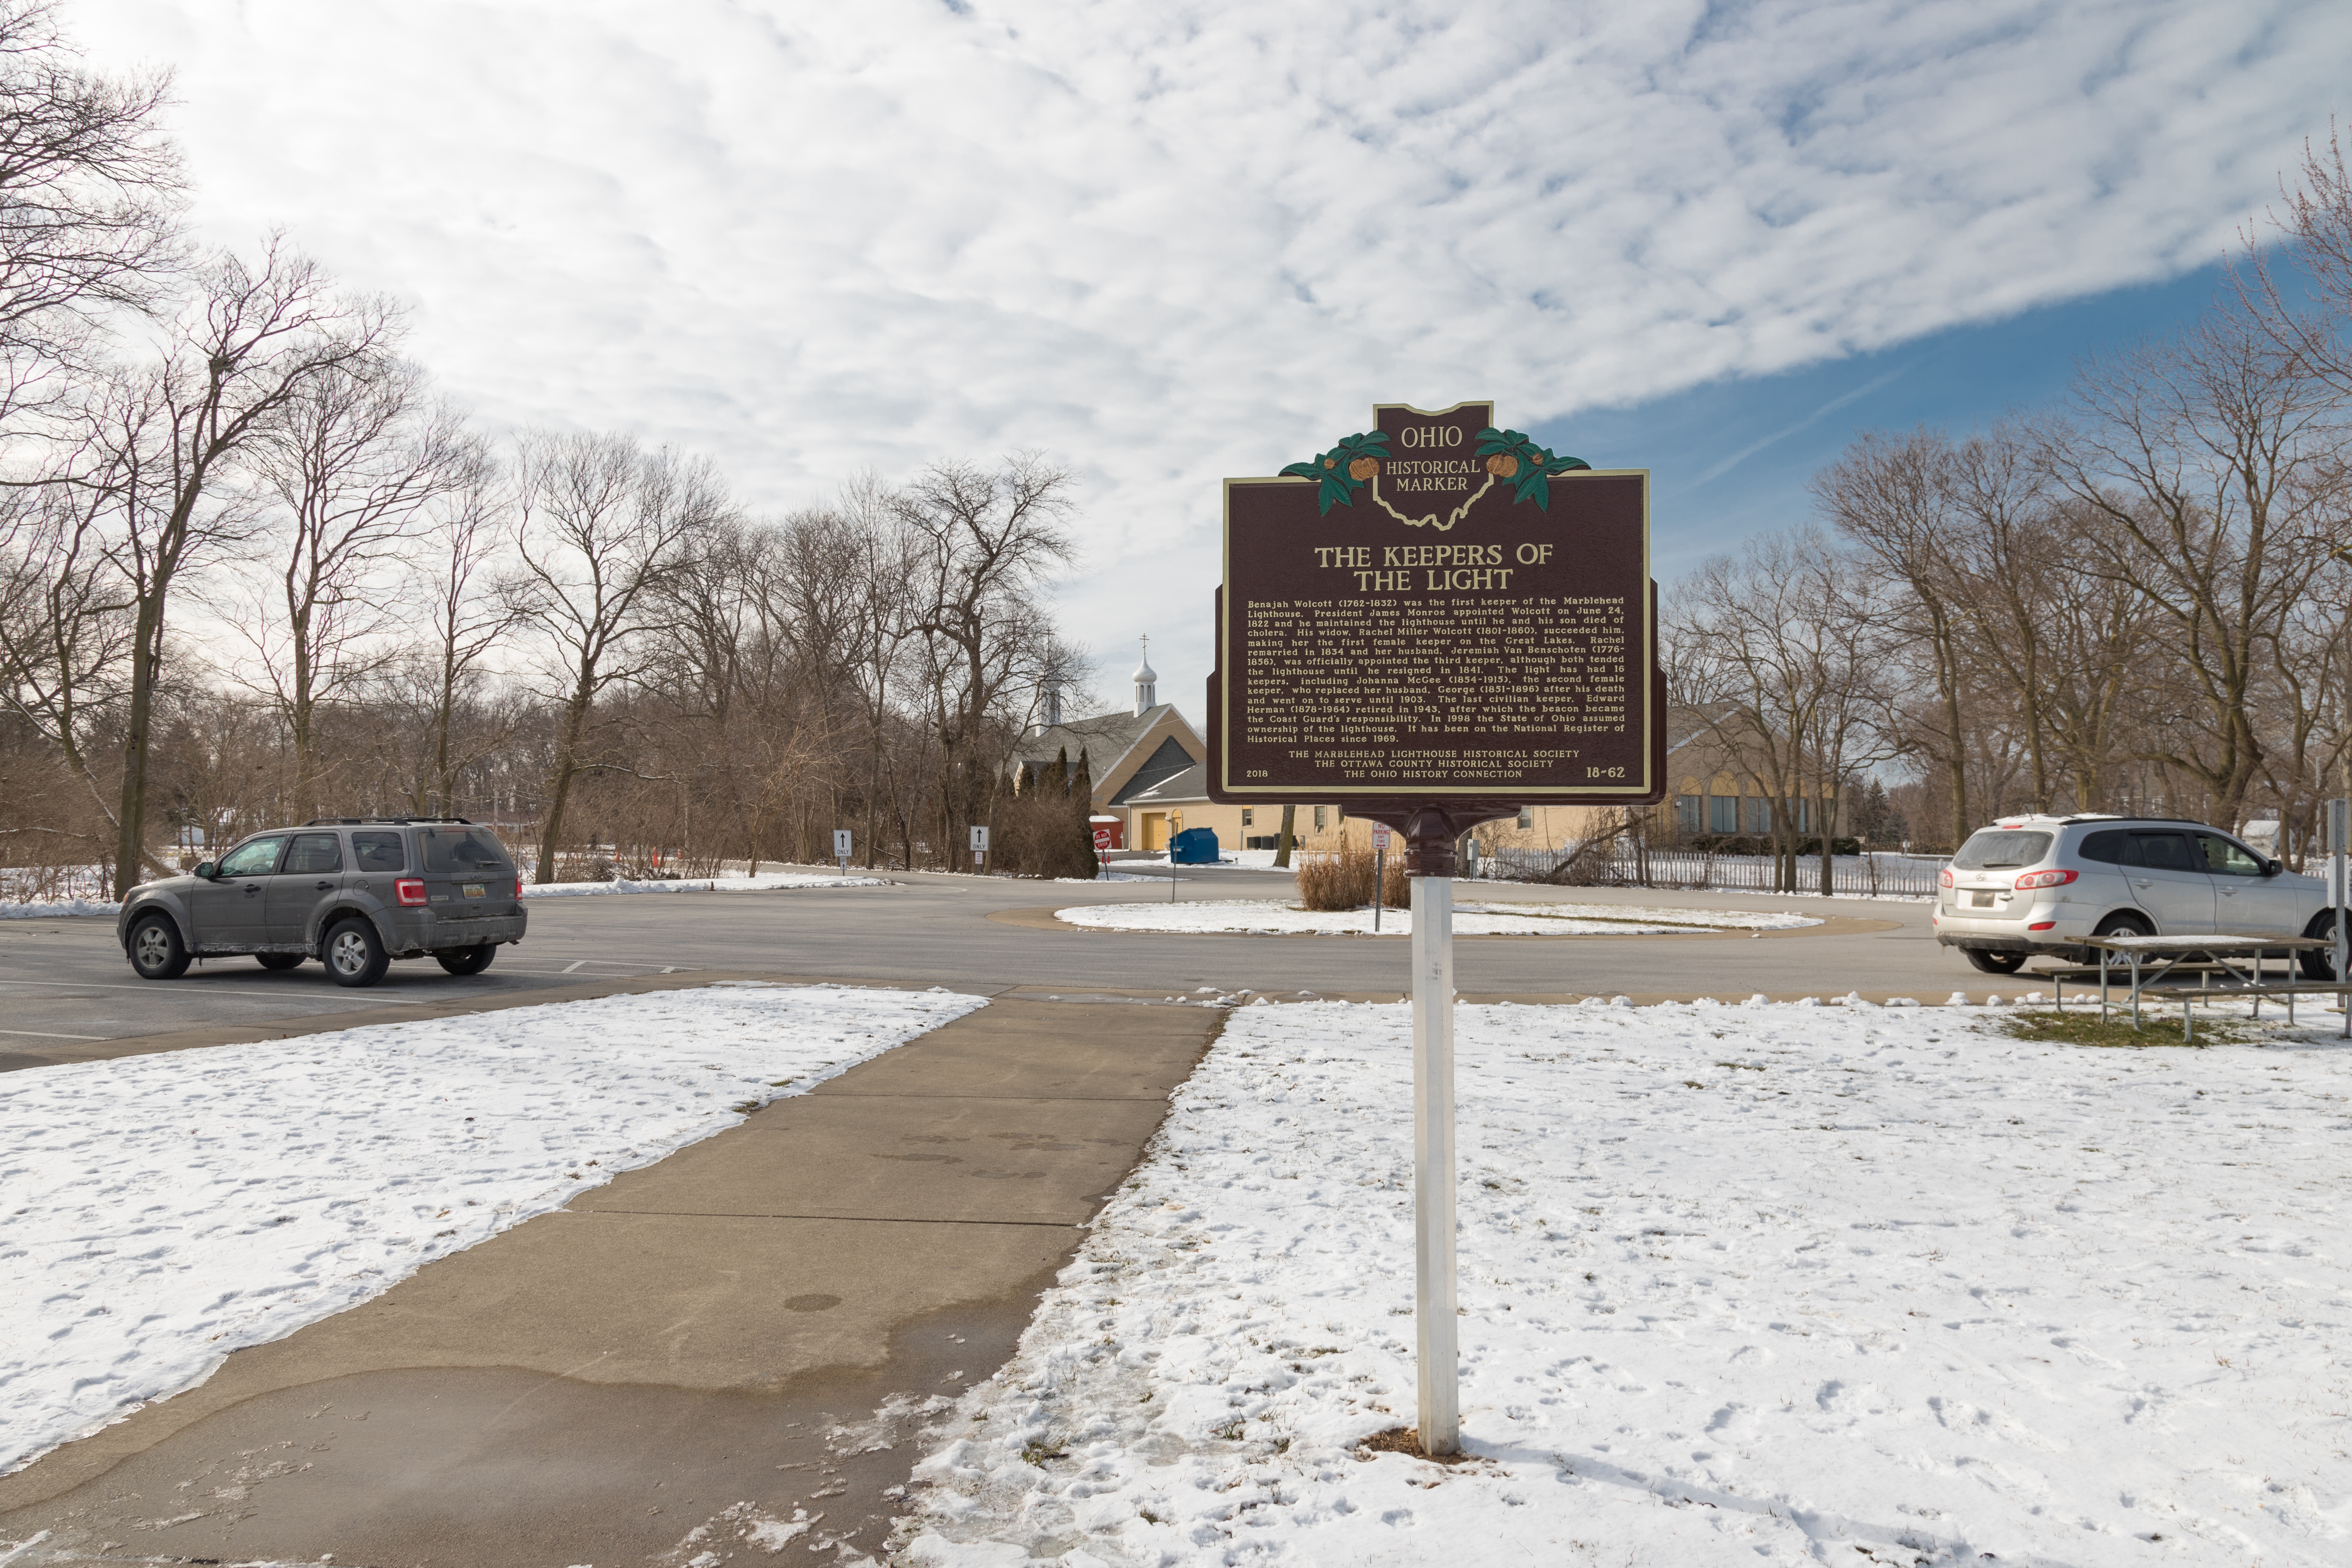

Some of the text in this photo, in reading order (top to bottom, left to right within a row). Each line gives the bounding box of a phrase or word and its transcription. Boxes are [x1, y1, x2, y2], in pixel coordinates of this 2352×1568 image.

[1401, 426, 1462, 448] OHIO
[1386, 460, 1480, 475] HISTORICAL
[1396, 477, 1468, 491] MARKER
[1314, 543, 1553, 567] THE KEEPERS OF
[1353, 569, 1513, 591] THE LIGHT
[1248, 601, 1289, 609] Benajah
[1481, 598, 1517, 606] keeper
[1248, 610, 1303, 619] Lighthouse.
[1454, 608, 1504, 617] appointed
[1608, 606, 1624, 615] 24,
[1402, 618, 1455, 627] lighthouse
[1248, 639, 1283, 648] making
[1416, 638, 1451, 646] keeper
[1307, 657, 1353, 665] officially
[1358, 657, 1408, 666] appointed
[1466, 657, 1503, 665] keeper,
[1510, 656, 1555, 665] although
[1248, 678, 1289, 686] keepers,
[1301, 677, 1348, 686] including
[1247, 687, 1284, 695] keeper,
[1316, 687, 1360, 695] replaced
[1438, 686, 1475, 695] George
[1414, 705, 1440, 713] 1943,
[1346, 715, 1421, 724] responsibility.
[1587, 767, 1625, 778] 18-62
